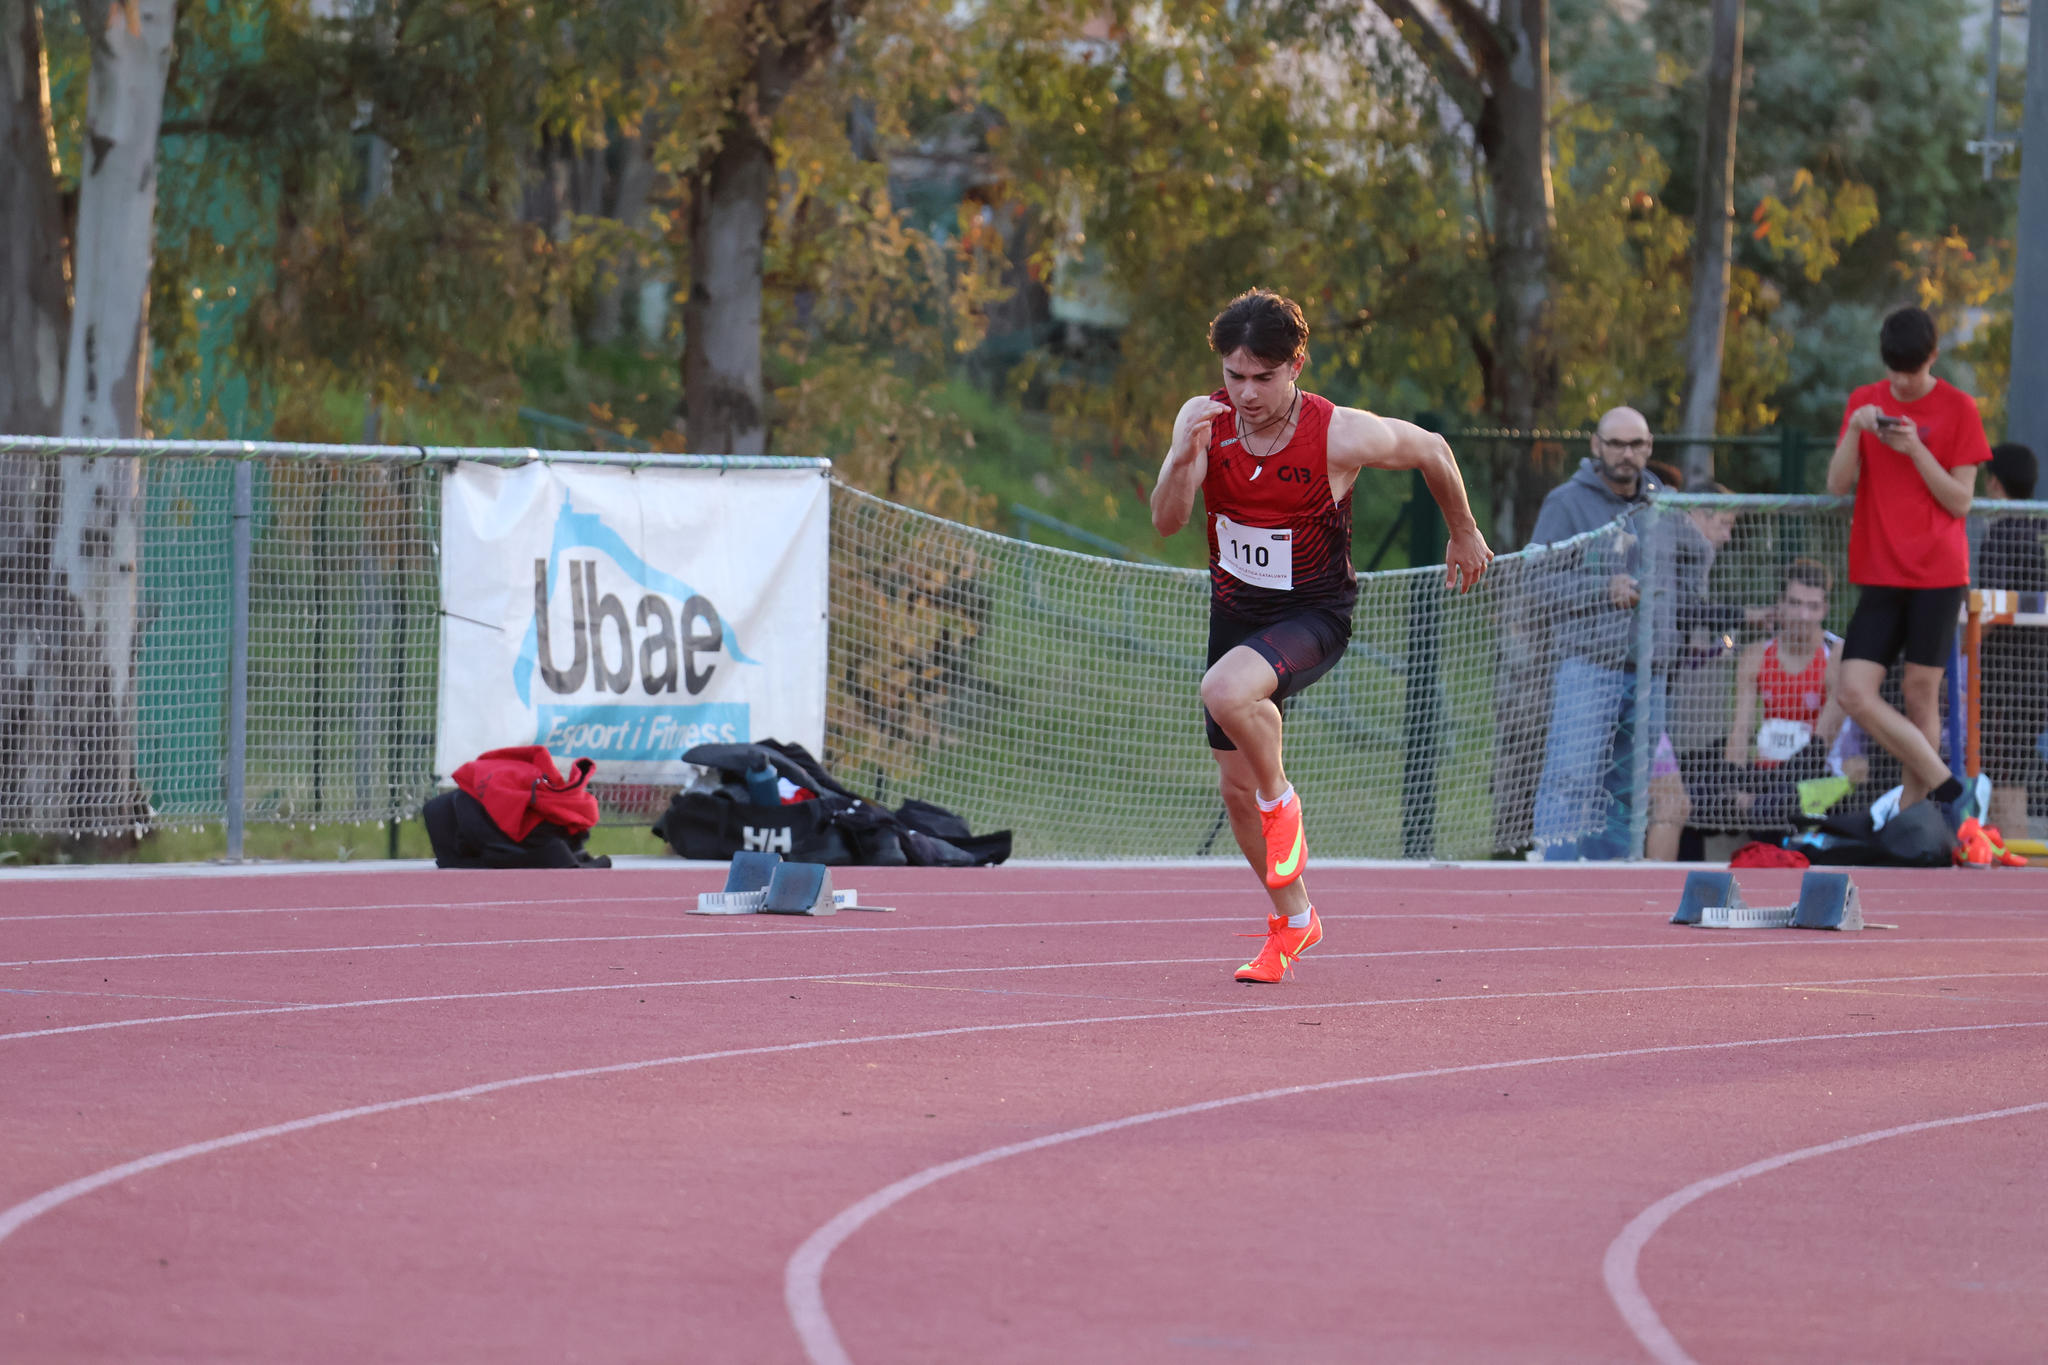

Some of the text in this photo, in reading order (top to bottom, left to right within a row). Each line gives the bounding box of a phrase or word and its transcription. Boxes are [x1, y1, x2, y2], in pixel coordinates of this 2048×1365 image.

[1231, 539, 1269, 567] 110
[535, 558, 723, 695] Ubae
[545, 714, 737, 755] Esport i Fitness
[743, 825, 792, 854] HH
